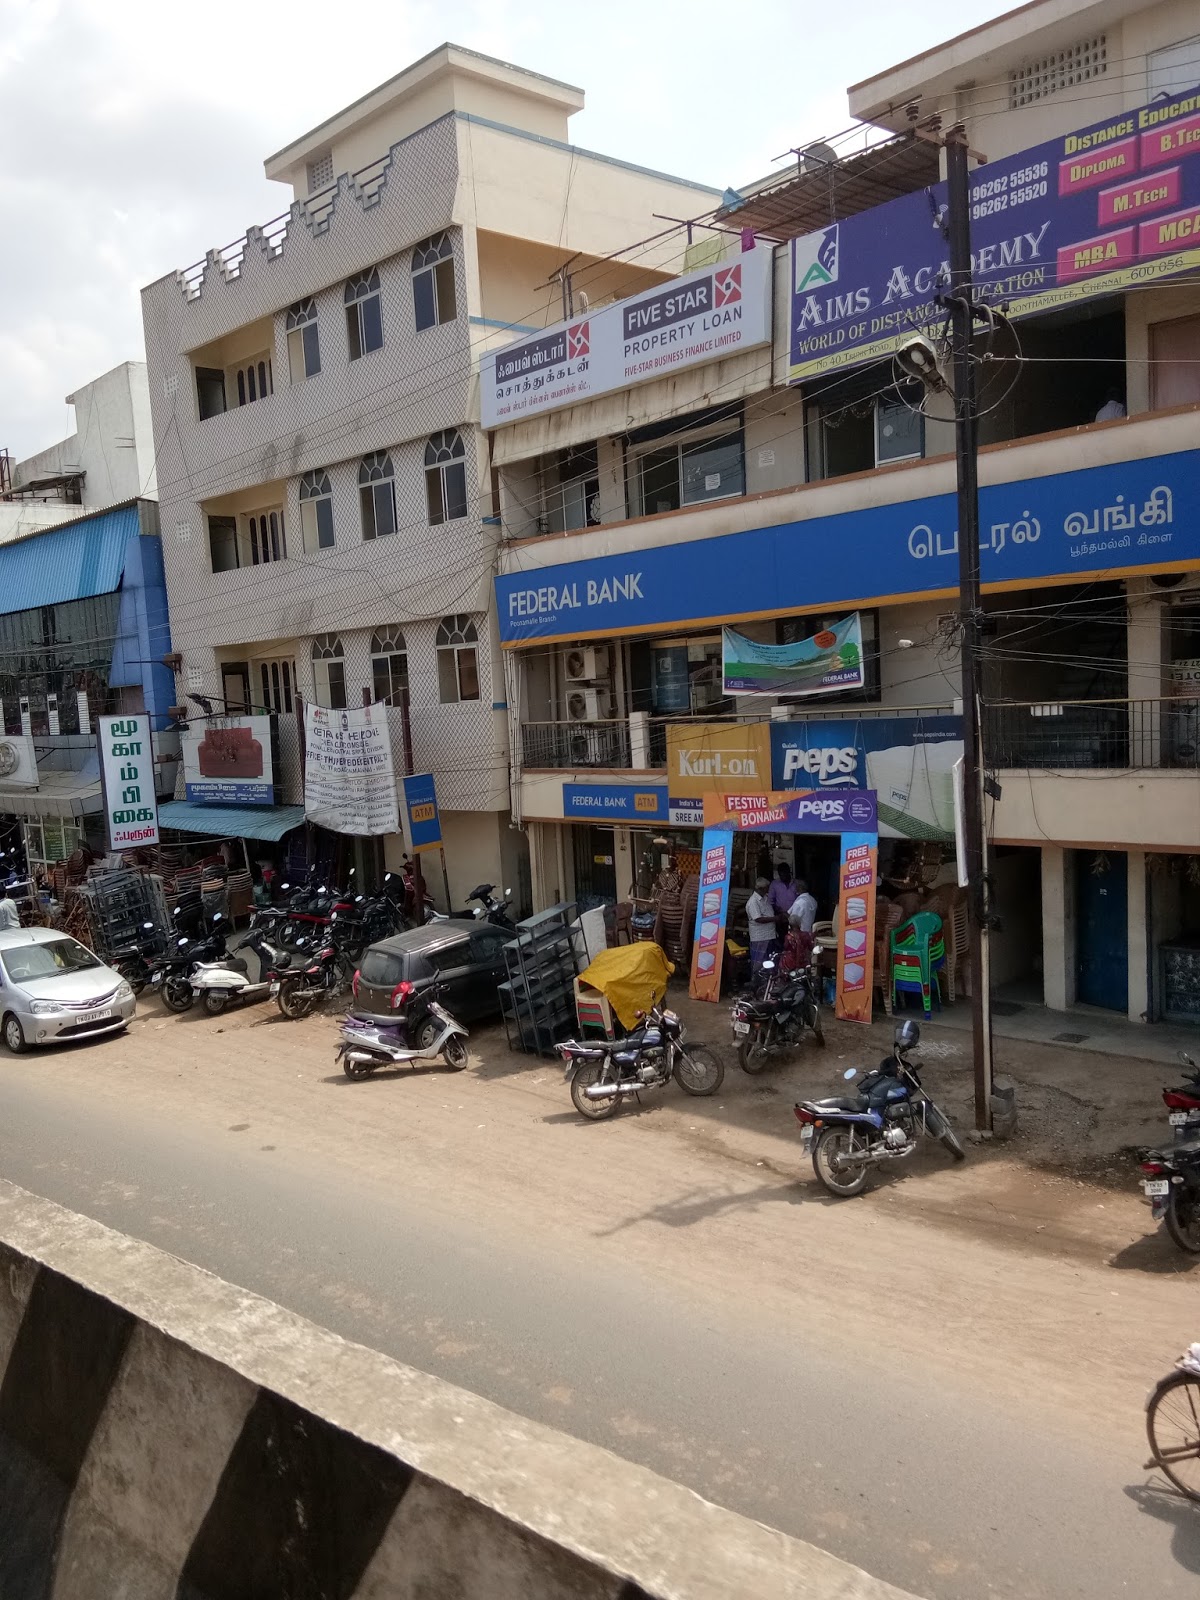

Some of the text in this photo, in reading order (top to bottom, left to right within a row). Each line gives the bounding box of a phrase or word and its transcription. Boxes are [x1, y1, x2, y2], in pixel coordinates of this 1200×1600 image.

[1064, 119, 1133, 156] DISTANCE
[972, 161, 1048, 202] 96262 55536
[1070, 153, 1126, 182] DIPLOMA
[972, 180, 1048, 220] 96262 55520
[1113, 185, 1168, 213] M.TECH
[1074, 241, 1119, 270] MBA
[796, 287, 871, 333] AIMS
[882, 220, 1051, 305] ACAEMY
[628, 286, 708, 331] FIVE STAR
[624, 305, 742, 358] PROPERTY LOAN
[799, 330, 845, 355] WORLD
[848, 323, 866, 338] OF
[624, 330, 742, 378] FIVE-STAR BUSINESS FINANCE LIMITED
[1063, 485, 1173, 537] வங்கி
[508, 572, 644, 617] FEDERAL BANK
[844, 671, 858, 679] BANK
[678, 749, 759, 777] Kurl-on
[783, 747, 858, 781] peps
[415, 806, 433, 819] ATM
[572, 795, 655, 808] FEDERAL BANK ATM
[727, 796, 767, 810] FESTIVE
[798, 799, 845, 820] peps
[675, 812, 692, 823] SREE
[741, 809, 785, 826] BONANZA
[707, 847, 724, 860] FREE
[707, 857, 726, 871] GIFTS
[847, 846, 868, 859] FREE
[848, 858, 871, 871] GIFTS
